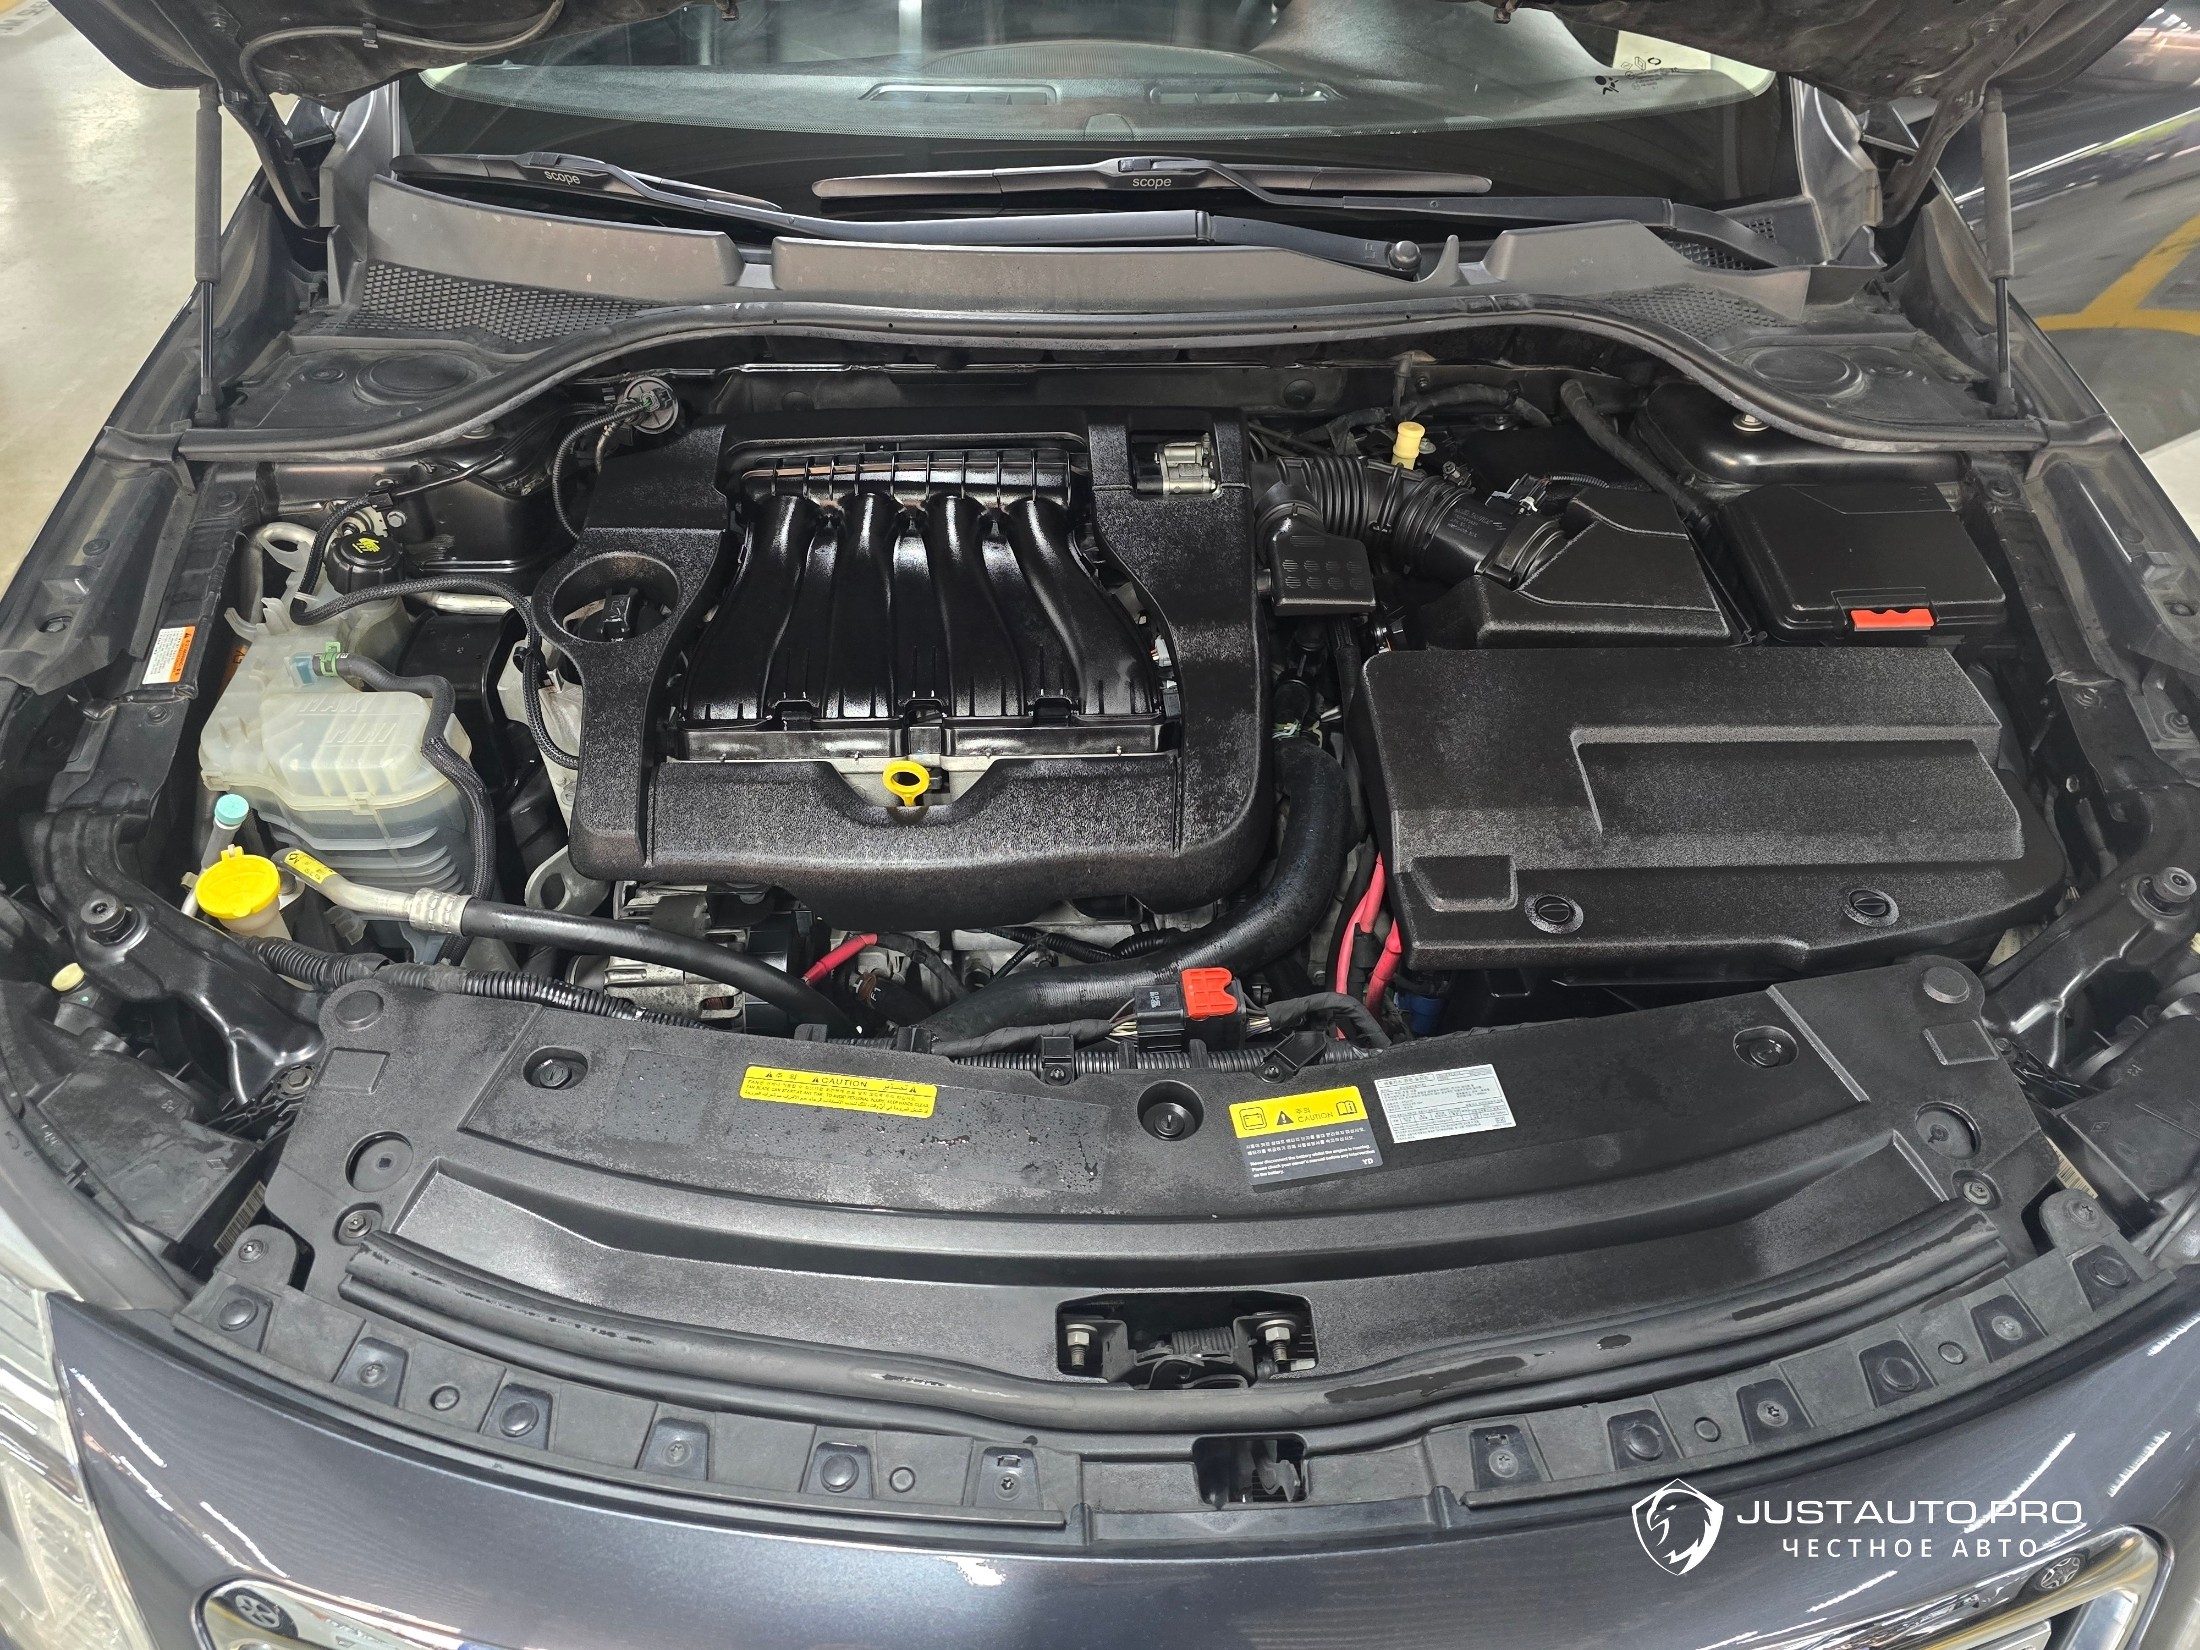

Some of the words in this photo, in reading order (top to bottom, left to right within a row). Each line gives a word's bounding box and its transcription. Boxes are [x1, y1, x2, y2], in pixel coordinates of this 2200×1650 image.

[544, 171, 581, 185] scope
[1132, 178, 1172, 189] scope
[822, 1078, 868, 1087] CAUTION
[1297, 1112, 1334, 1123] CAUTION
